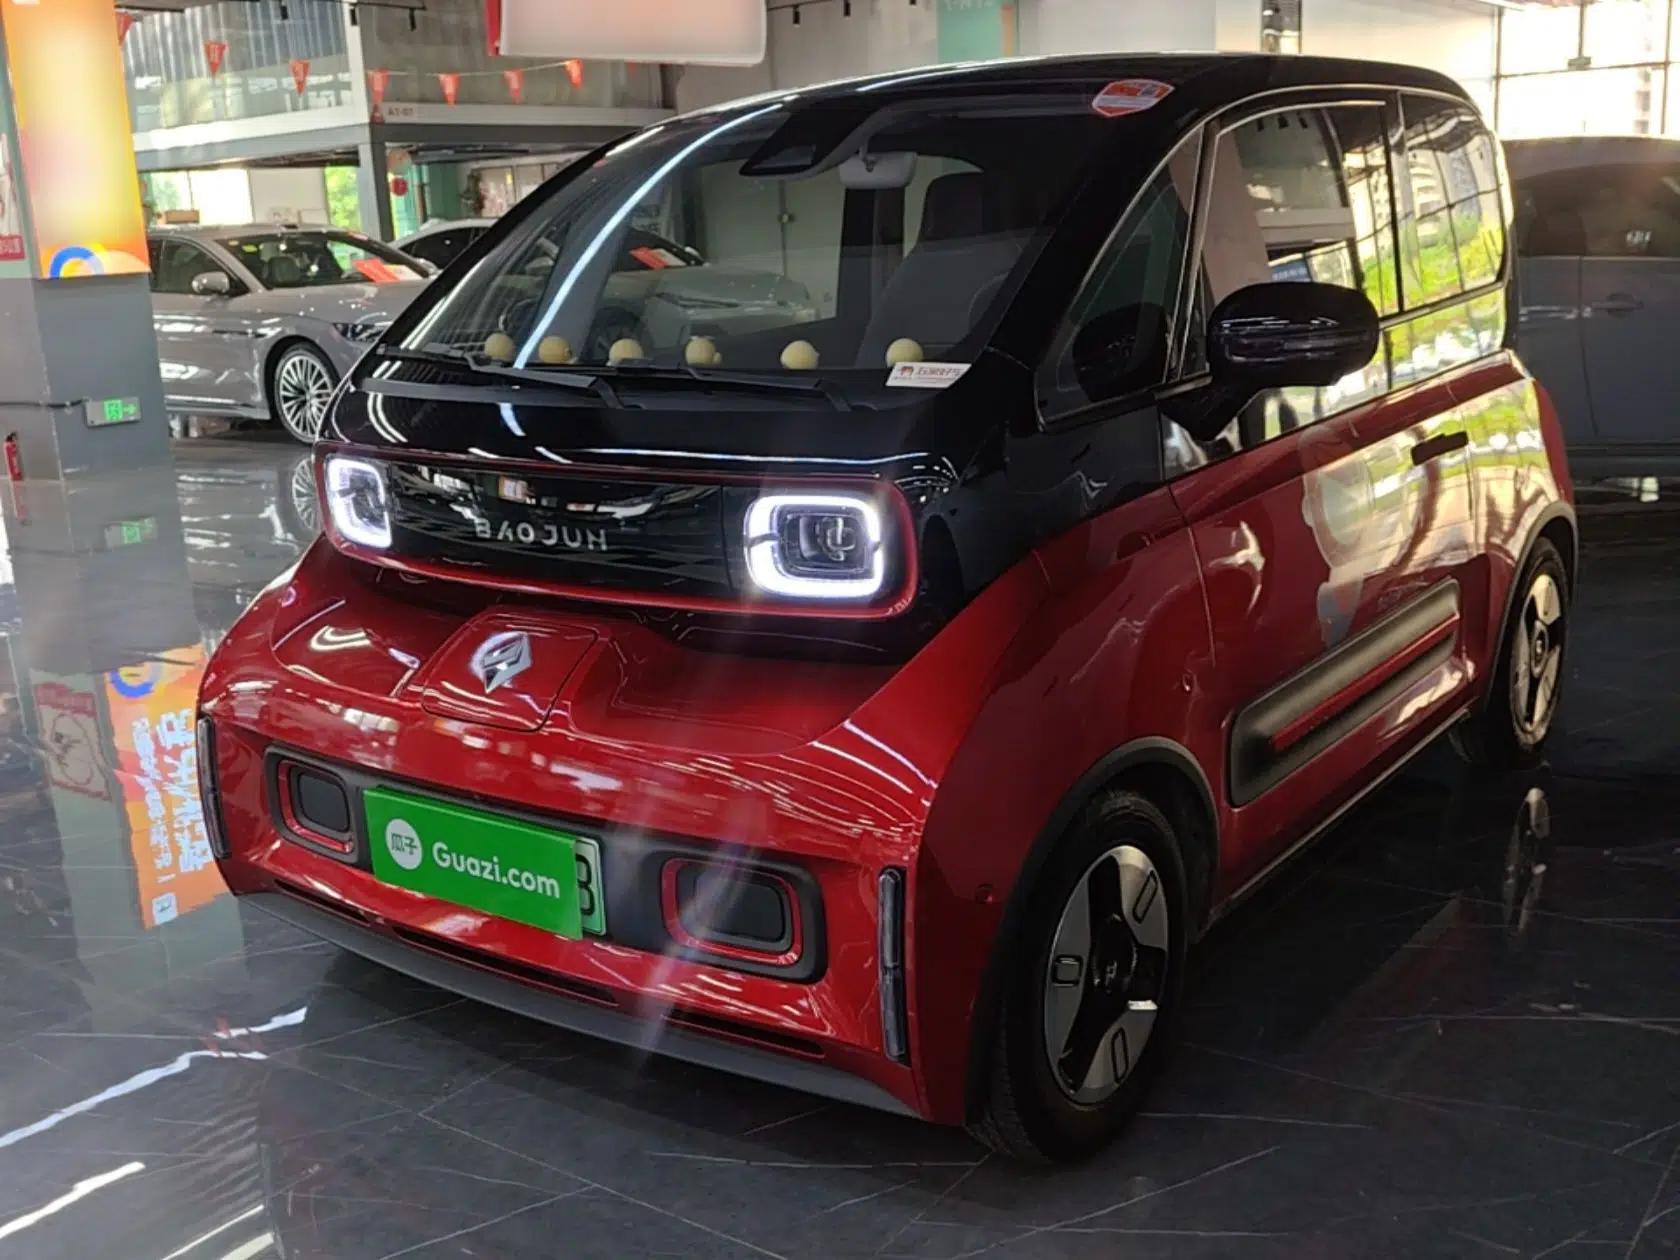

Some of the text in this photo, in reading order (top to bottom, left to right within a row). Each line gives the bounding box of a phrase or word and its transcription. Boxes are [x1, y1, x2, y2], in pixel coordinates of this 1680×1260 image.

[473, 517, 608, 551] BAOJUN
[391, 832, 417, 856] 瓜子
[432, 841, 560, 899] Guazi.com
